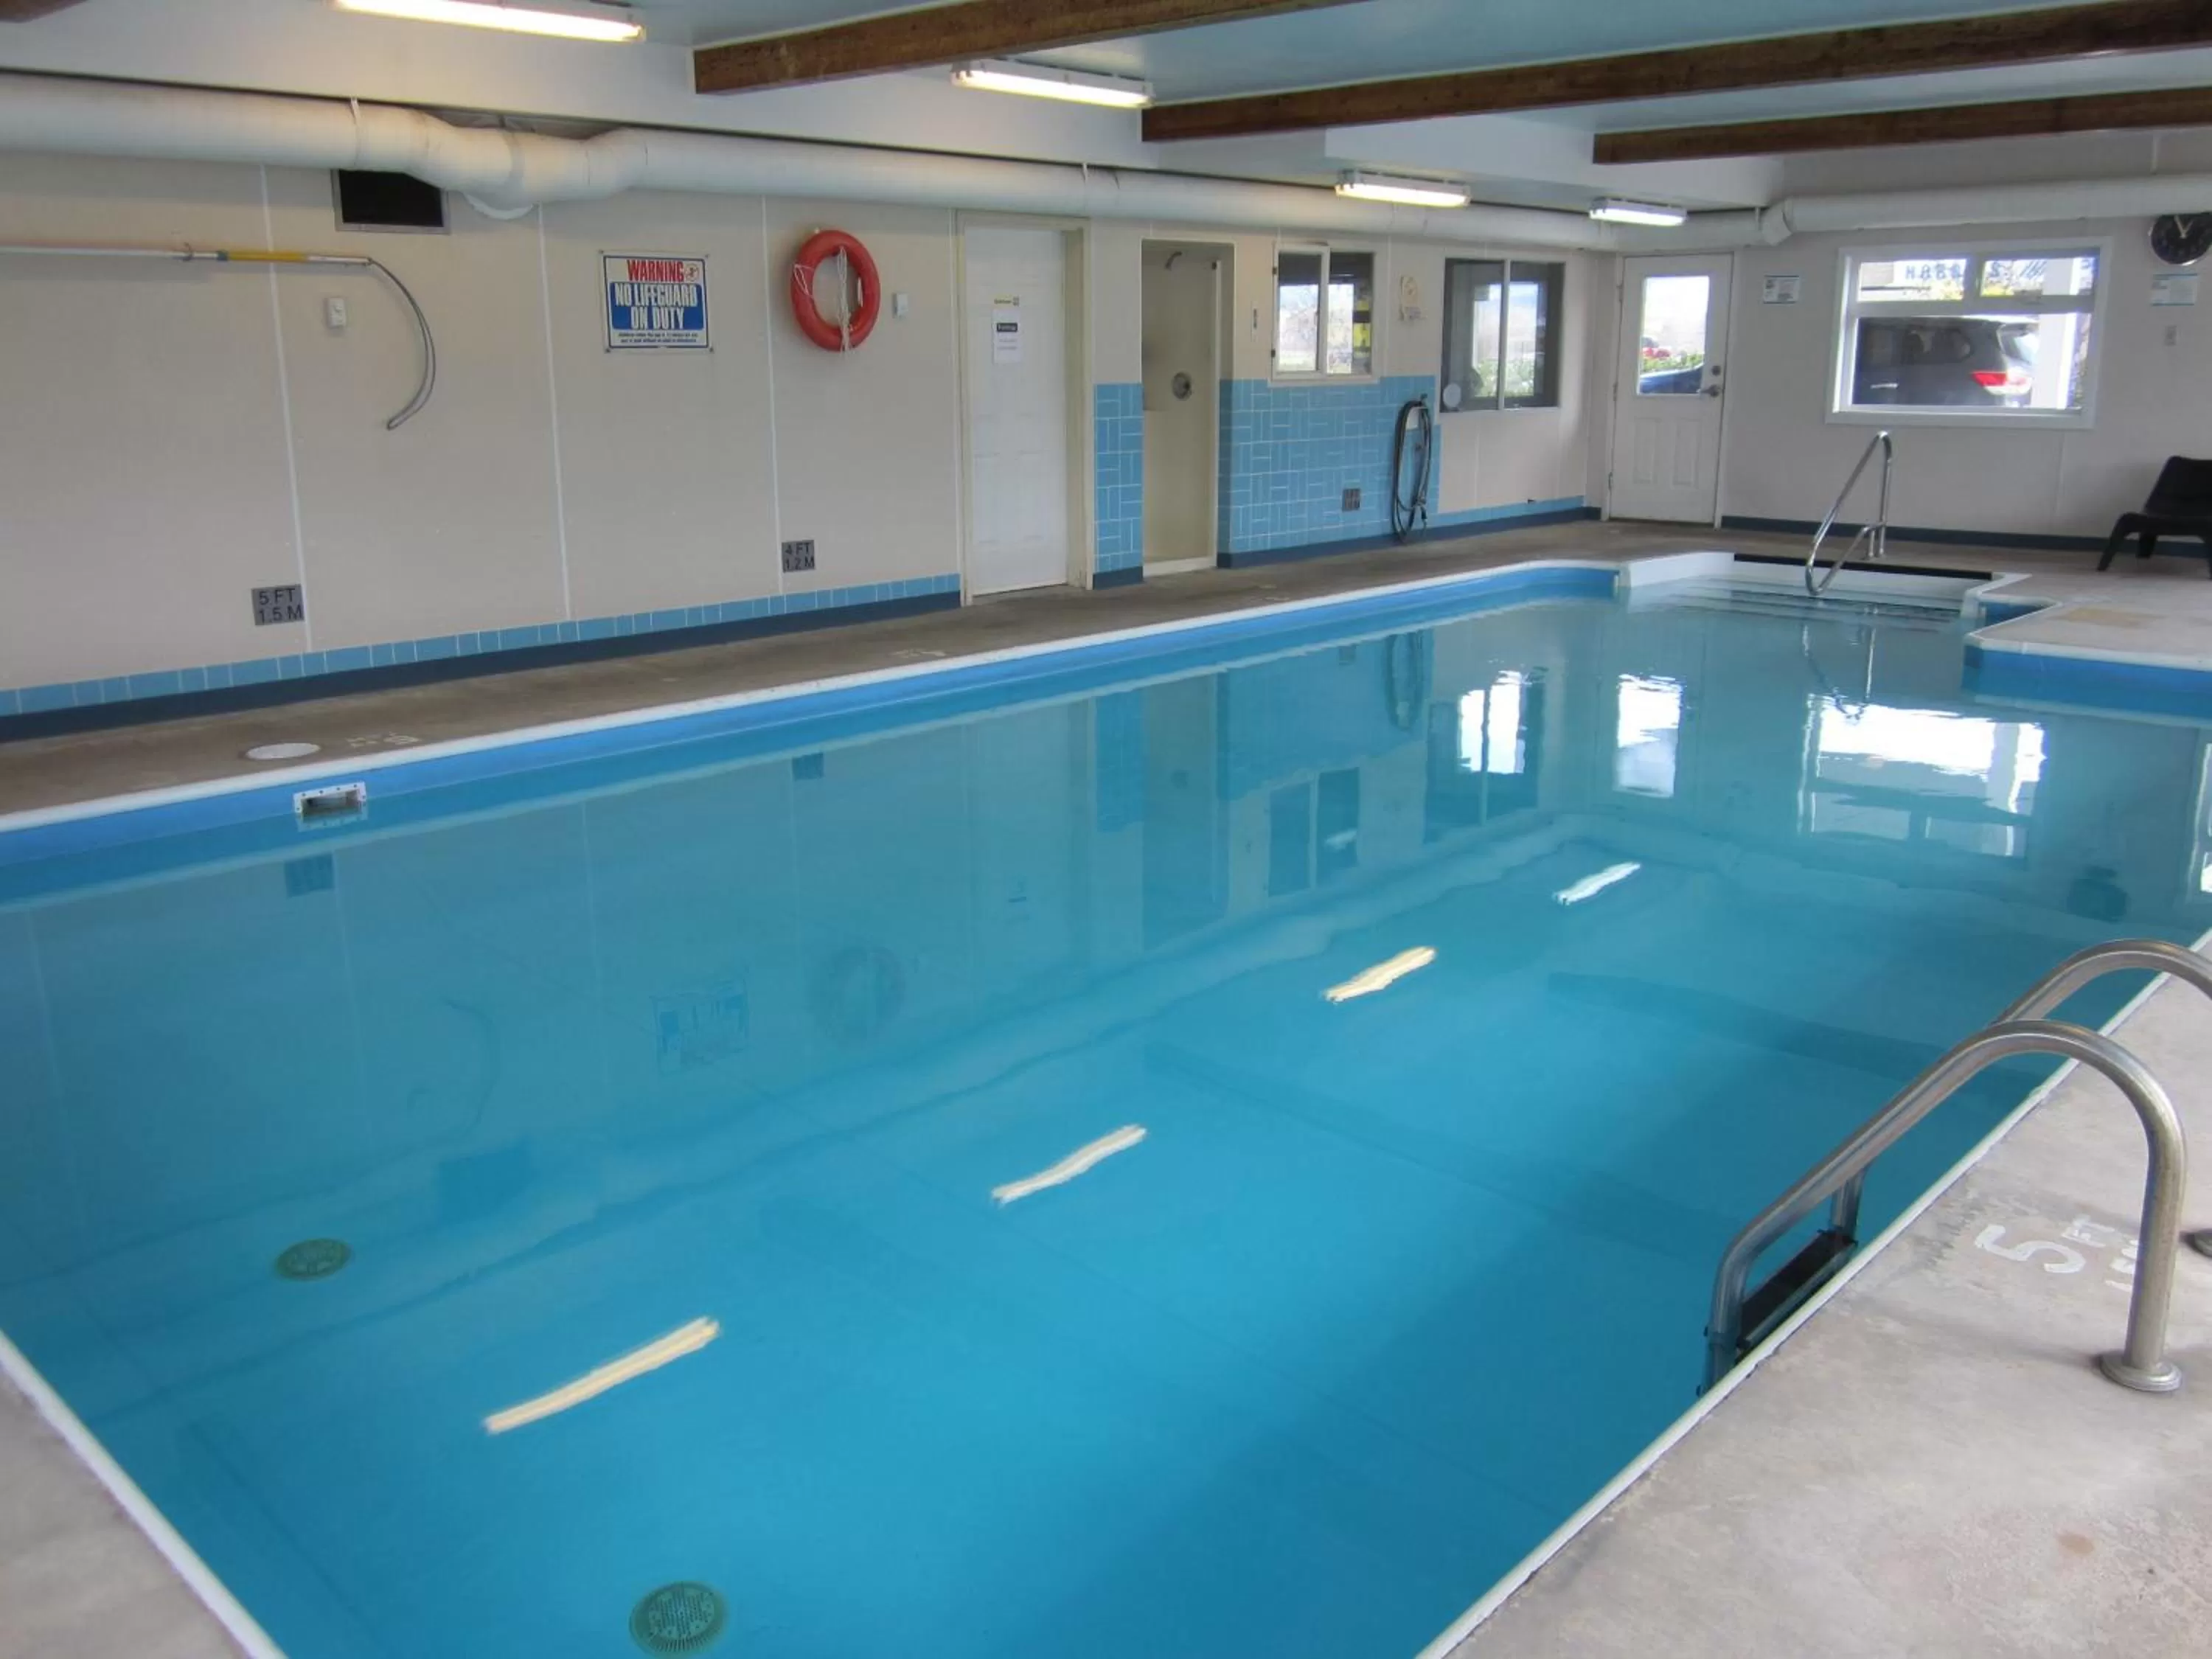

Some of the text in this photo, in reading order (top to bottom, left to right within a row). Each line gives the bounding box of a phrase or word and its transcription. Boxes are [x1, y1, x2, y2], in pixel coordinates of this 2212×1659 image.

[627, 260, 685, 282] WARNING
[615, 283, 698, 307] NO LIFEGUARD
[630, 307, 685, 330] ON DUTY
[796, 542, 812, 554] FT
[259, 588, 296, 605] 5 FT
[1975, 1225, 2086, 1273] 5
